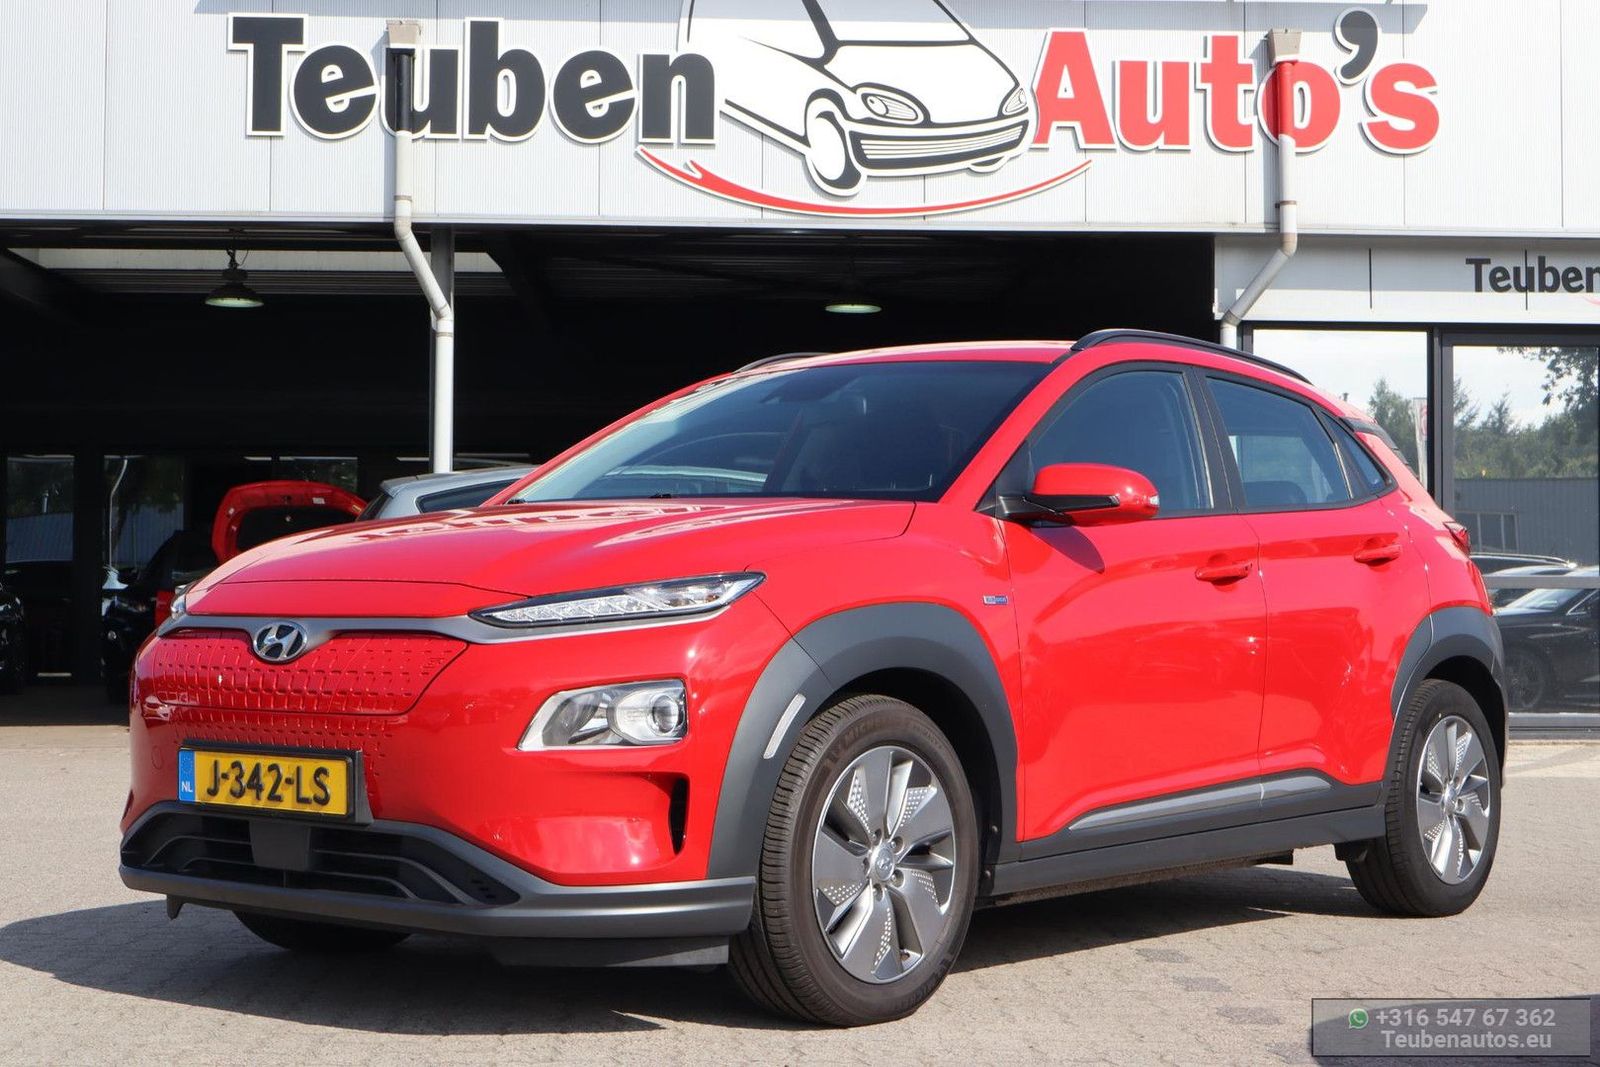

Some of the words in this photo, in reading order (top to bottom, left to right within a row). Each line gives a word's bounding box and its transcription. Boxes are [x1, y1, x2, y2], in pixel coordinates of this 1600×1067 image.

[231, 15, 716, 143] Teuben
[1033, 9, 1439, 152] Auto's
[181, 780, 193, 793] NL
[206, 760, 331, 805] J-342-LS
